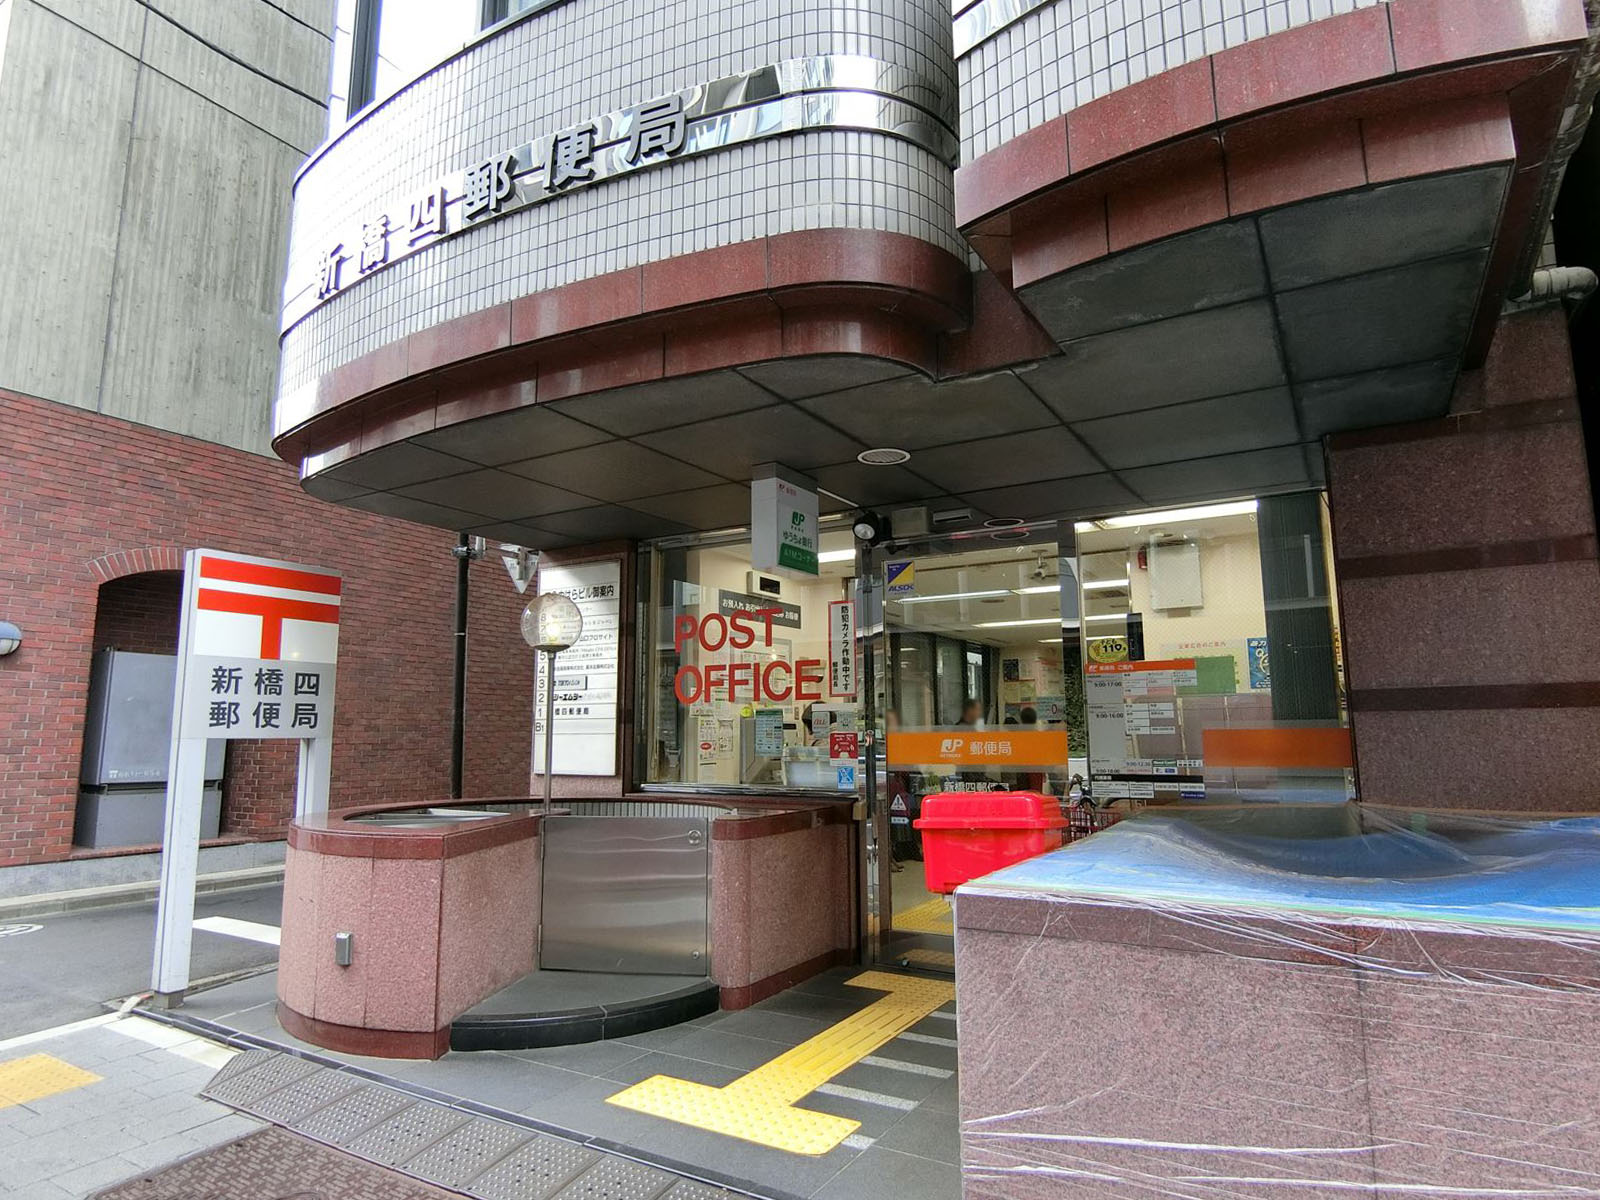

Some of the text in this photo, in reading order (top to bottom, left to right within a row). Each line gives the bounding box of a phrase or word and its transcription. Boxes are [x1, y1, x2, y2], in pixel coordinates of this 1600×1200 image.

[314, 94, 687, 299] 新橋四郵便局
[783, 531, 812, 549] ゆうちょ銀行
[674, 606, 784, 654] POST
[841, 605, 850, 691] 防犯カメラ作動中です
[211, 666, 320, 697] 新橋四
[538, 666, 545, 674] 4
[538, 679, 545, 688] 3
[674, 660, 821, 705] OFFICE
[538, 693, 545, 703] 2
[208, 701, 318, 729] 郵便局
[554, 707, 589, 716] 橋四郵便局
[970, 741, 1012, 756] 郵便局
